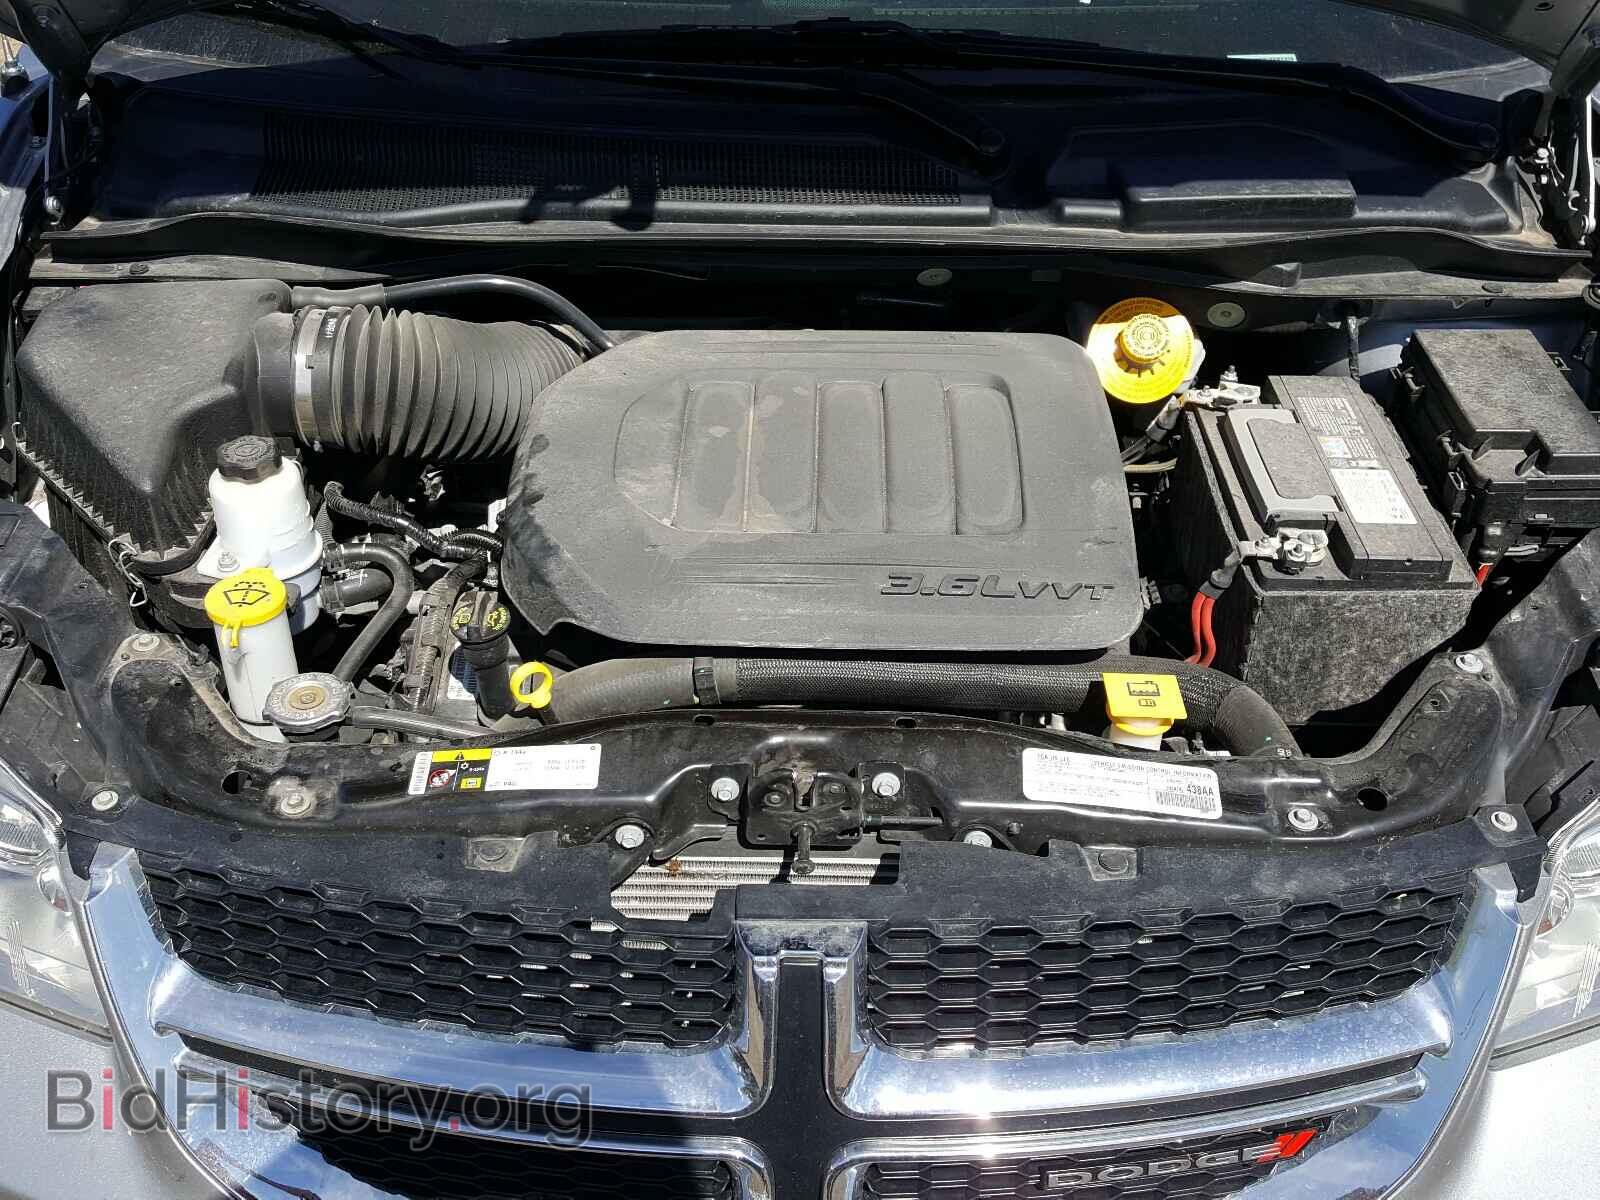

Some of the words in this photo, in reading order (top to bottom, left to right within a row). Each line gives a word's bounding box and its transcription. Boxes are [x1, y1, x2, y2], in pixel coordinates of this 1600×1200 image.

[880, 574, 1016, 599] 3.6L
[1017, 581, 1115, 600] VVT
[1046, 1143, 1281, 1190] DODGE
